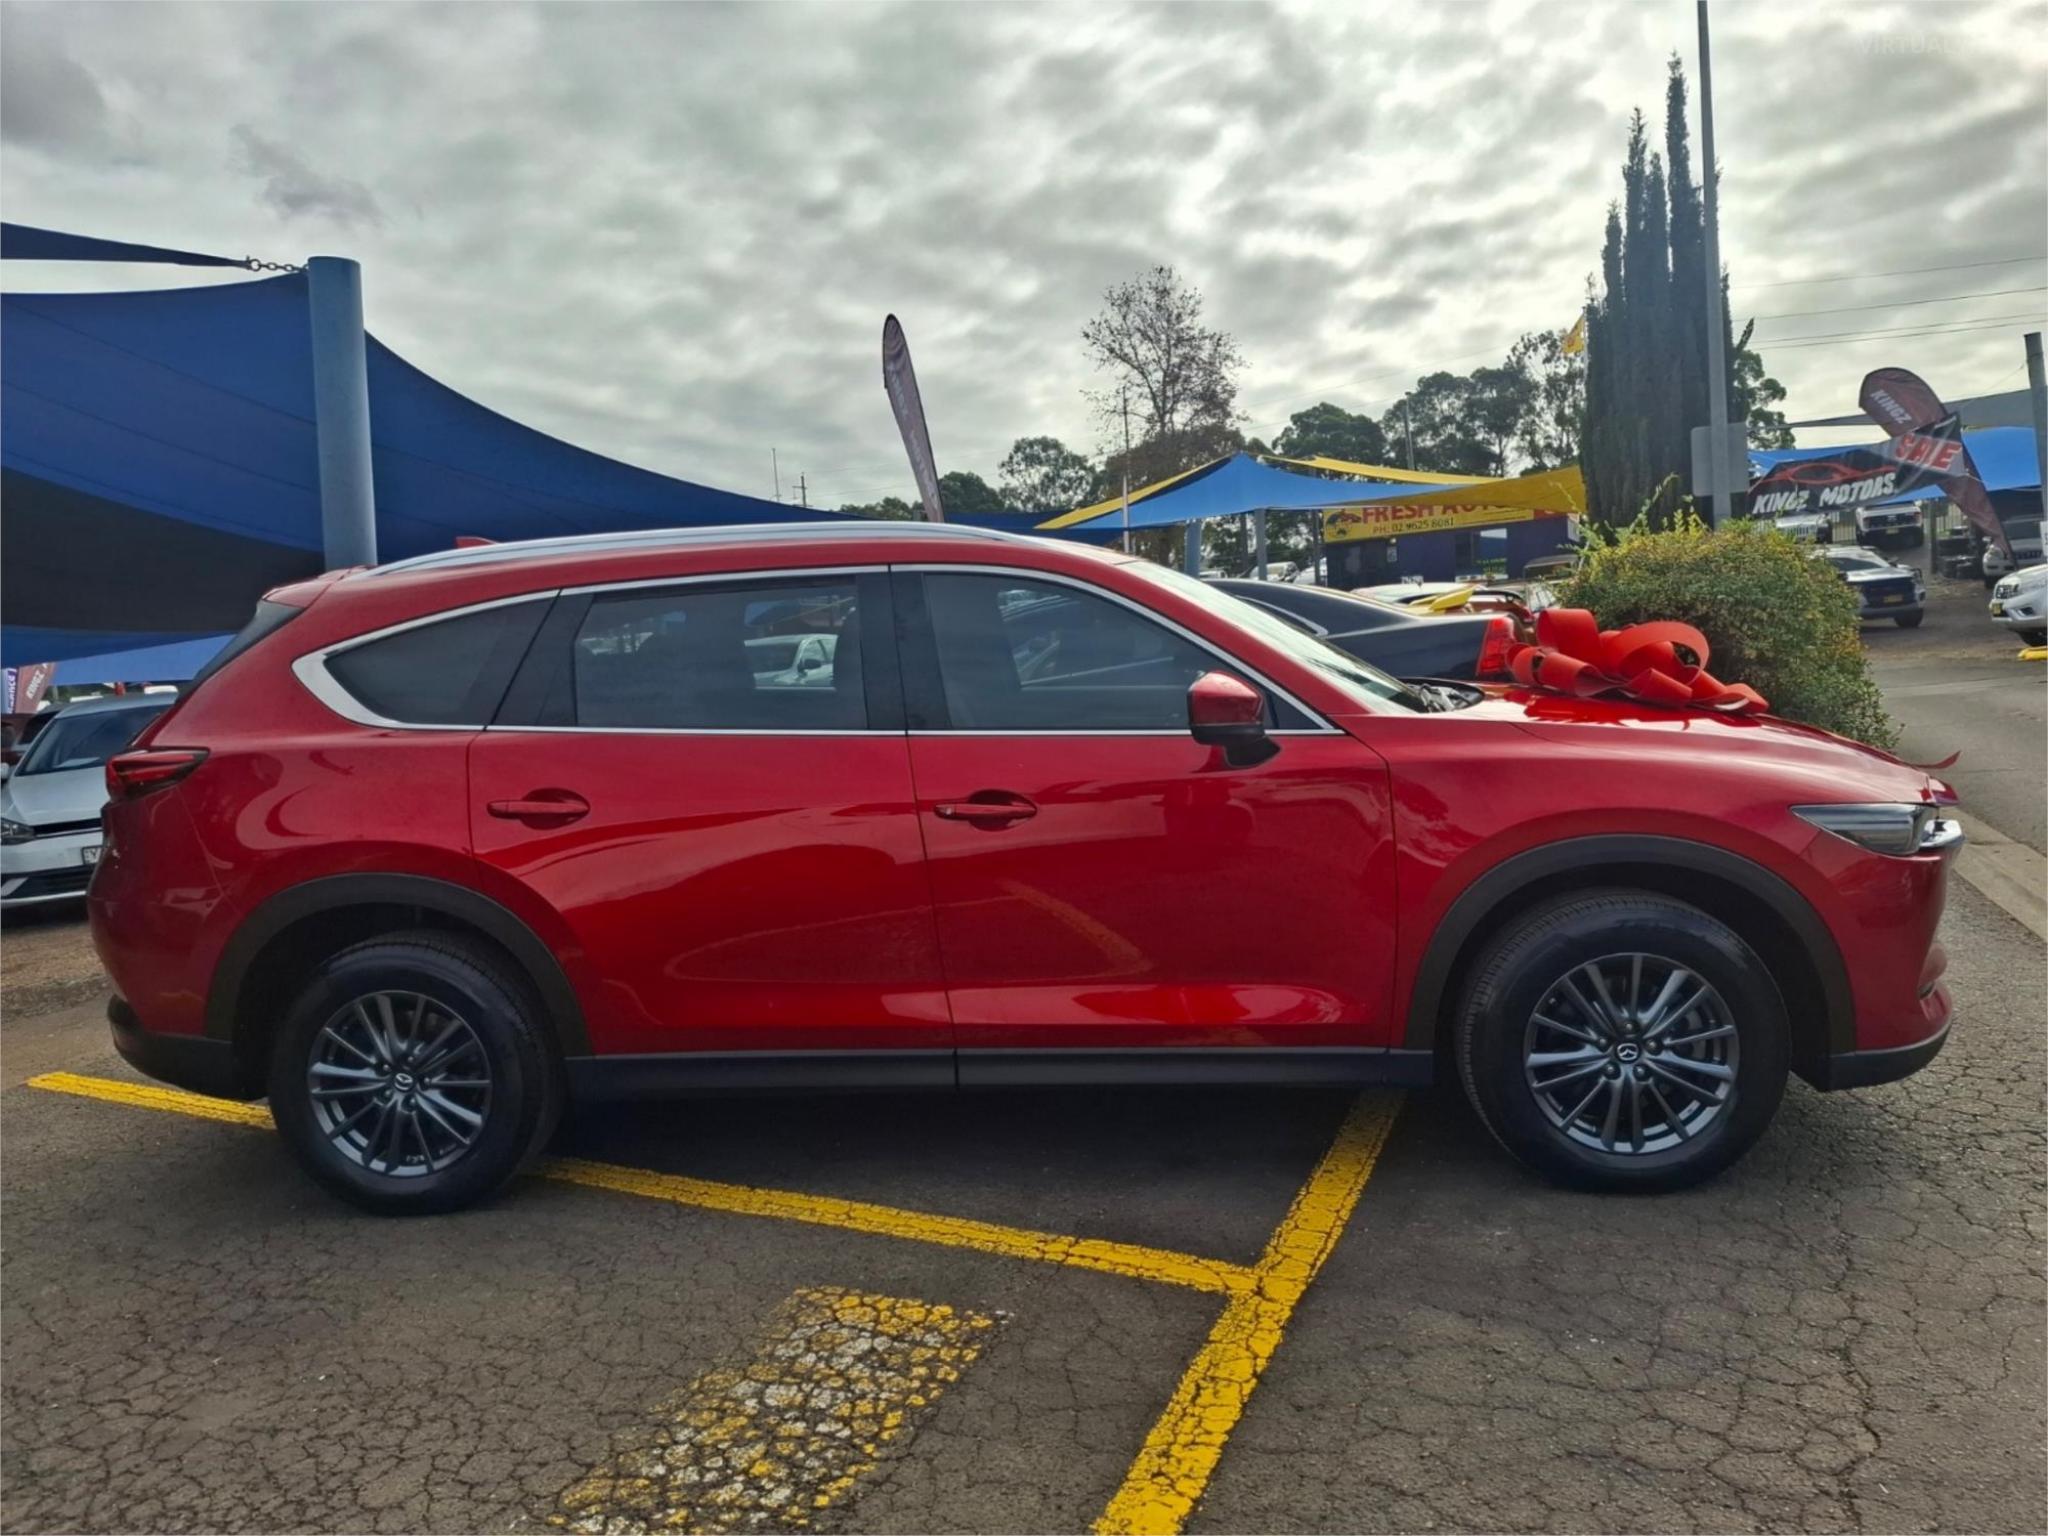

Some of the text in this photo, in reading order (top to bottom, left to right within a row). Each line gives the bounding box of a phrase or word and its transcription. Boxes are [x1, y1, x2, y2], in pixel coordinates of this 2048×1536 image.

[1870, 390, 1911, 424] KINGZ
[1752, 473, 1896, 515] KINGZ MOTORS
[1361, 505, 1433, 523] FRESH
[1392, 522, 1403, 532] 02
